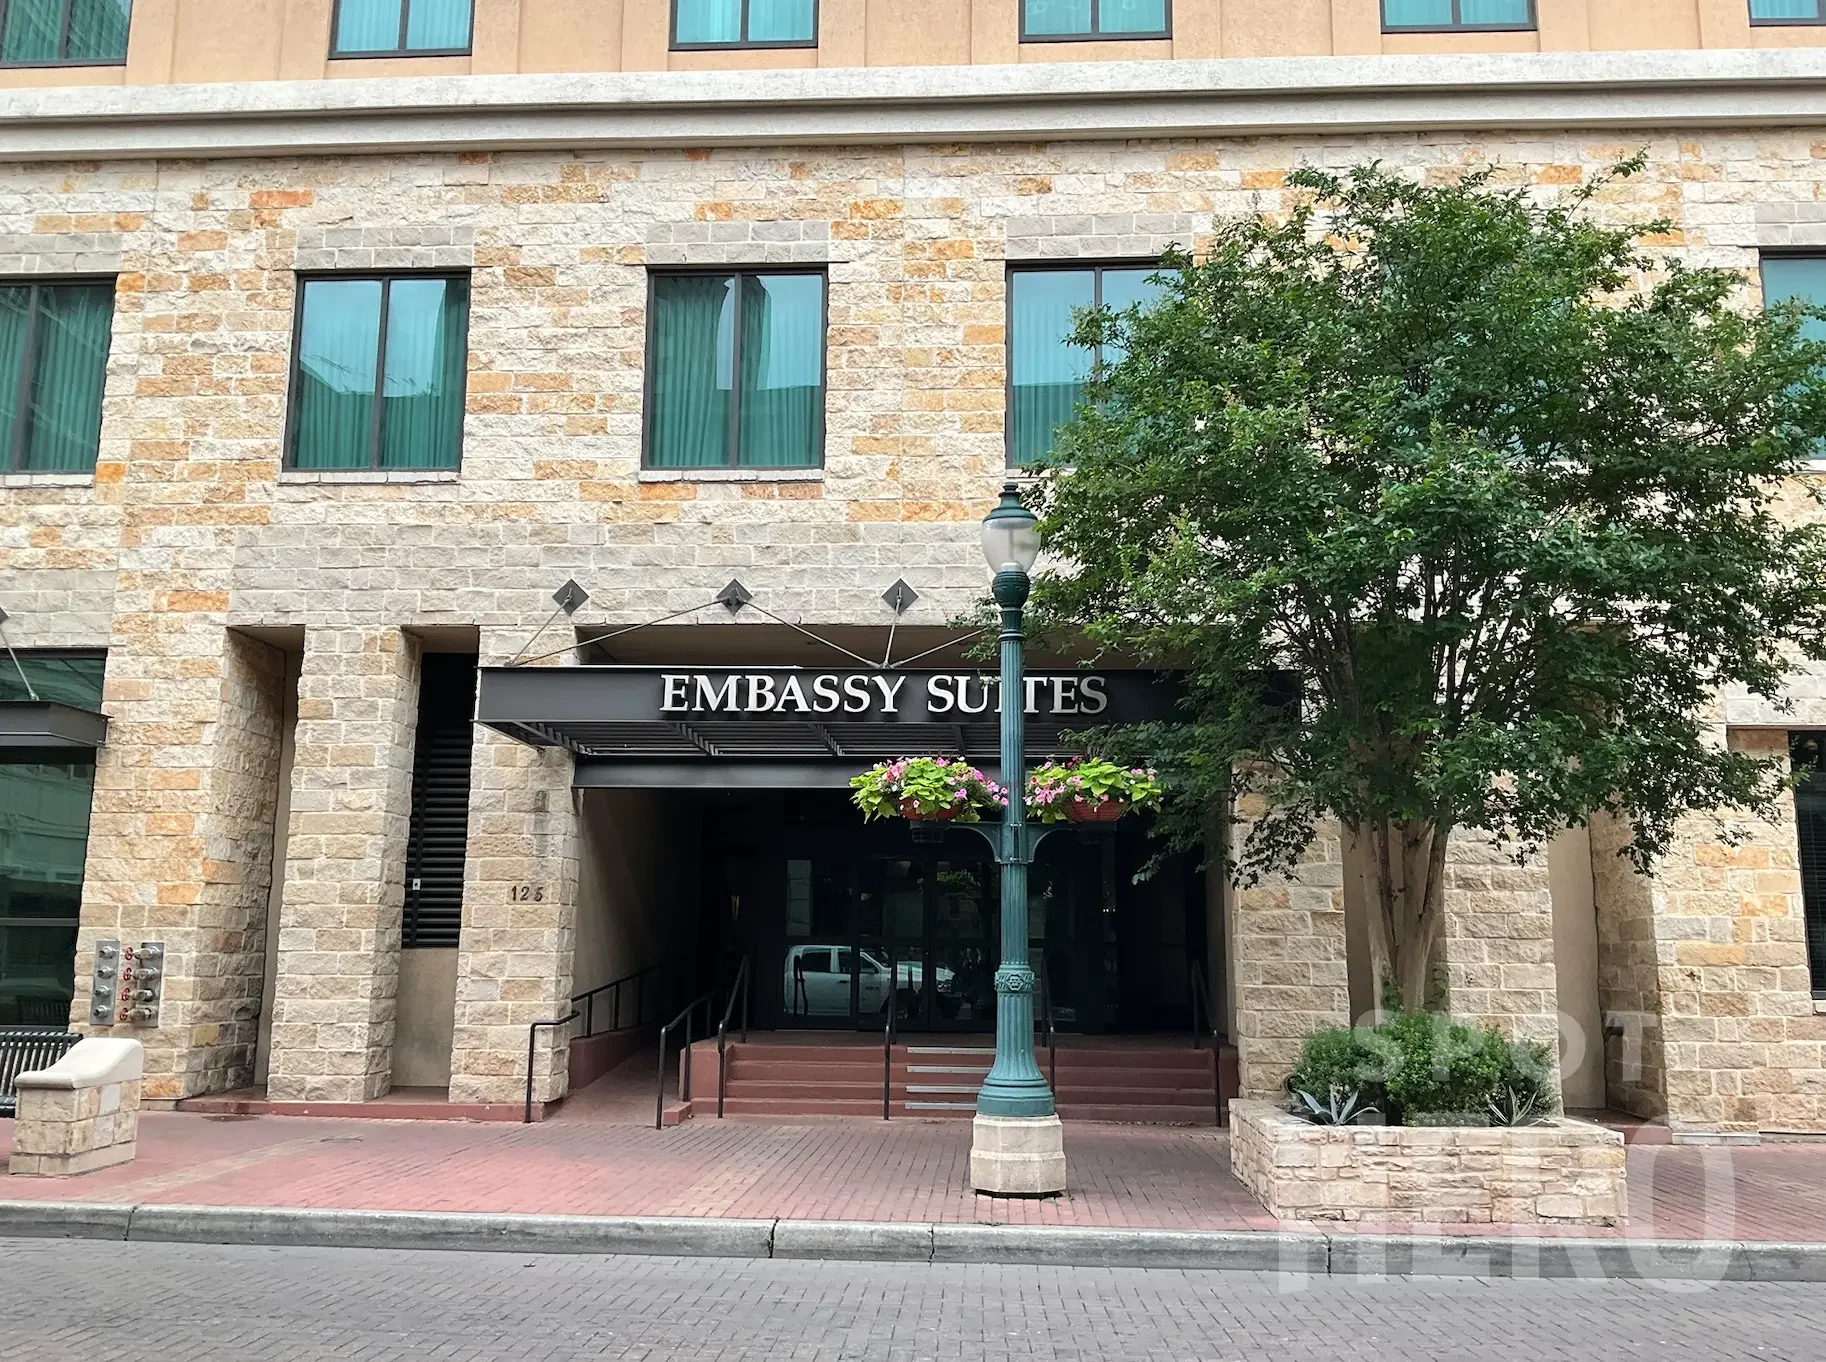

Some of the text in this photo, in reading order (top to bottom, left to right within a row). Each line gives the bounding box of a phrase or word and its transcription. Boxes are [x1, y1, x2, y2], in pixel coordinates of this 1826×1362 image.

[659, 673, 1108, 714] EMBASSY SUTES
[511, 885, 544, 902] 125
